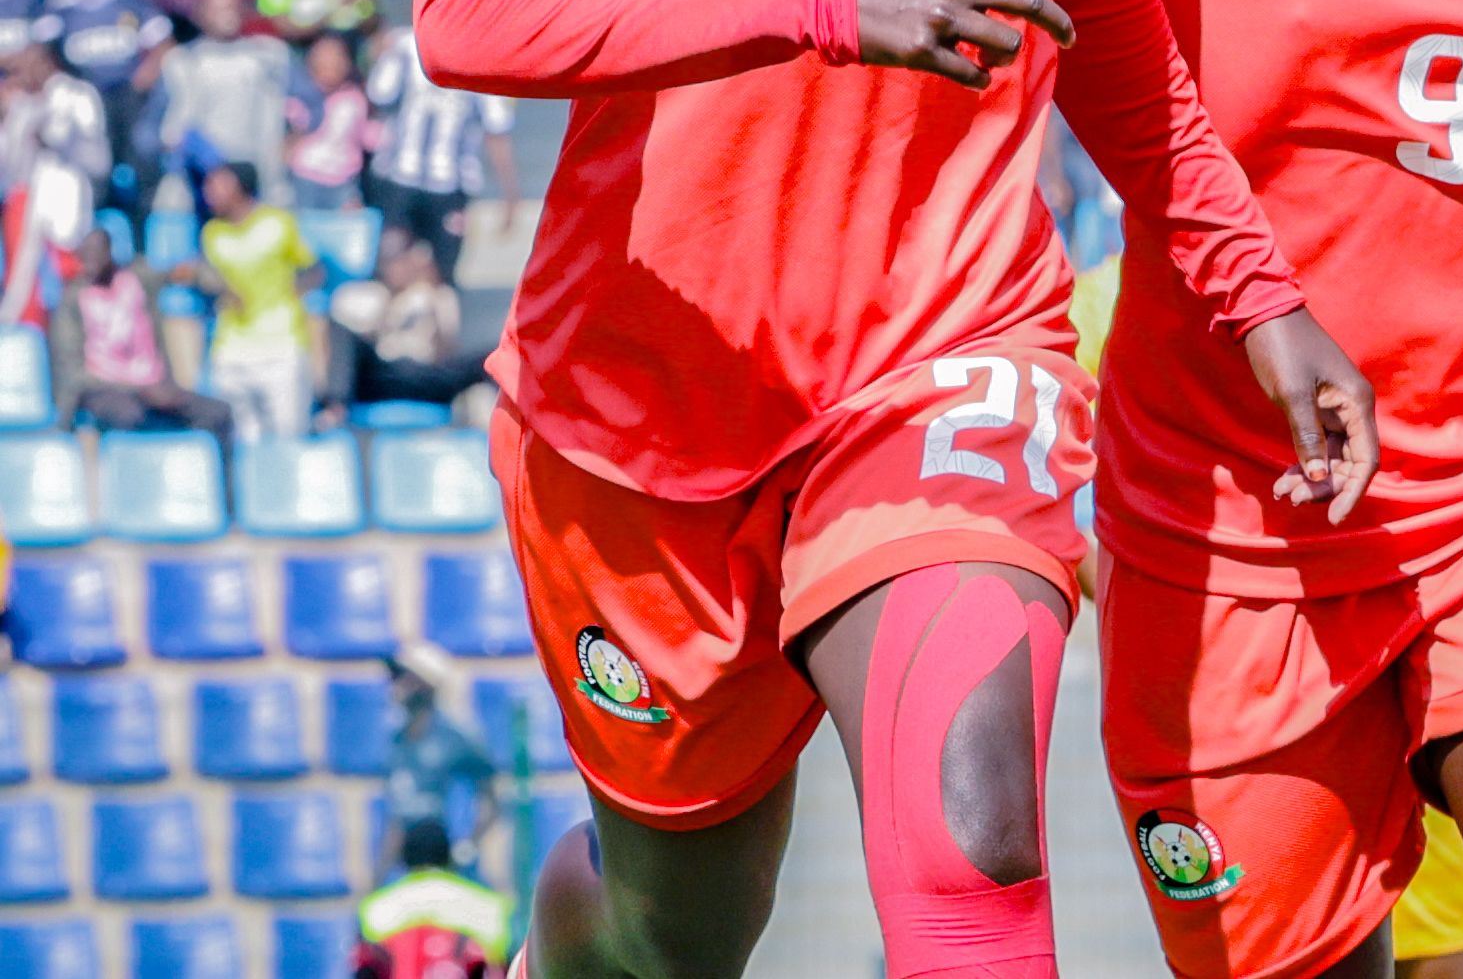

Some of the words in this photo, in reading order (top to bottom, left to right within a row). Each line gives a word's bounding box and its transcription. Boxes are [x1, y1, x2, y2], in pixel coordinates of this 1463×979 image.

[920, 356, 1062, 500] 21
[578, 631, 596, 685] FOOTBALL
[592, 692, 653, 721] FEDERATION
[1139, 827, 1166, 881] FOOTBALL
[1195, 822, 1222, 862] KENYA
[1169, 878, 1229, 899] FEDERATION
